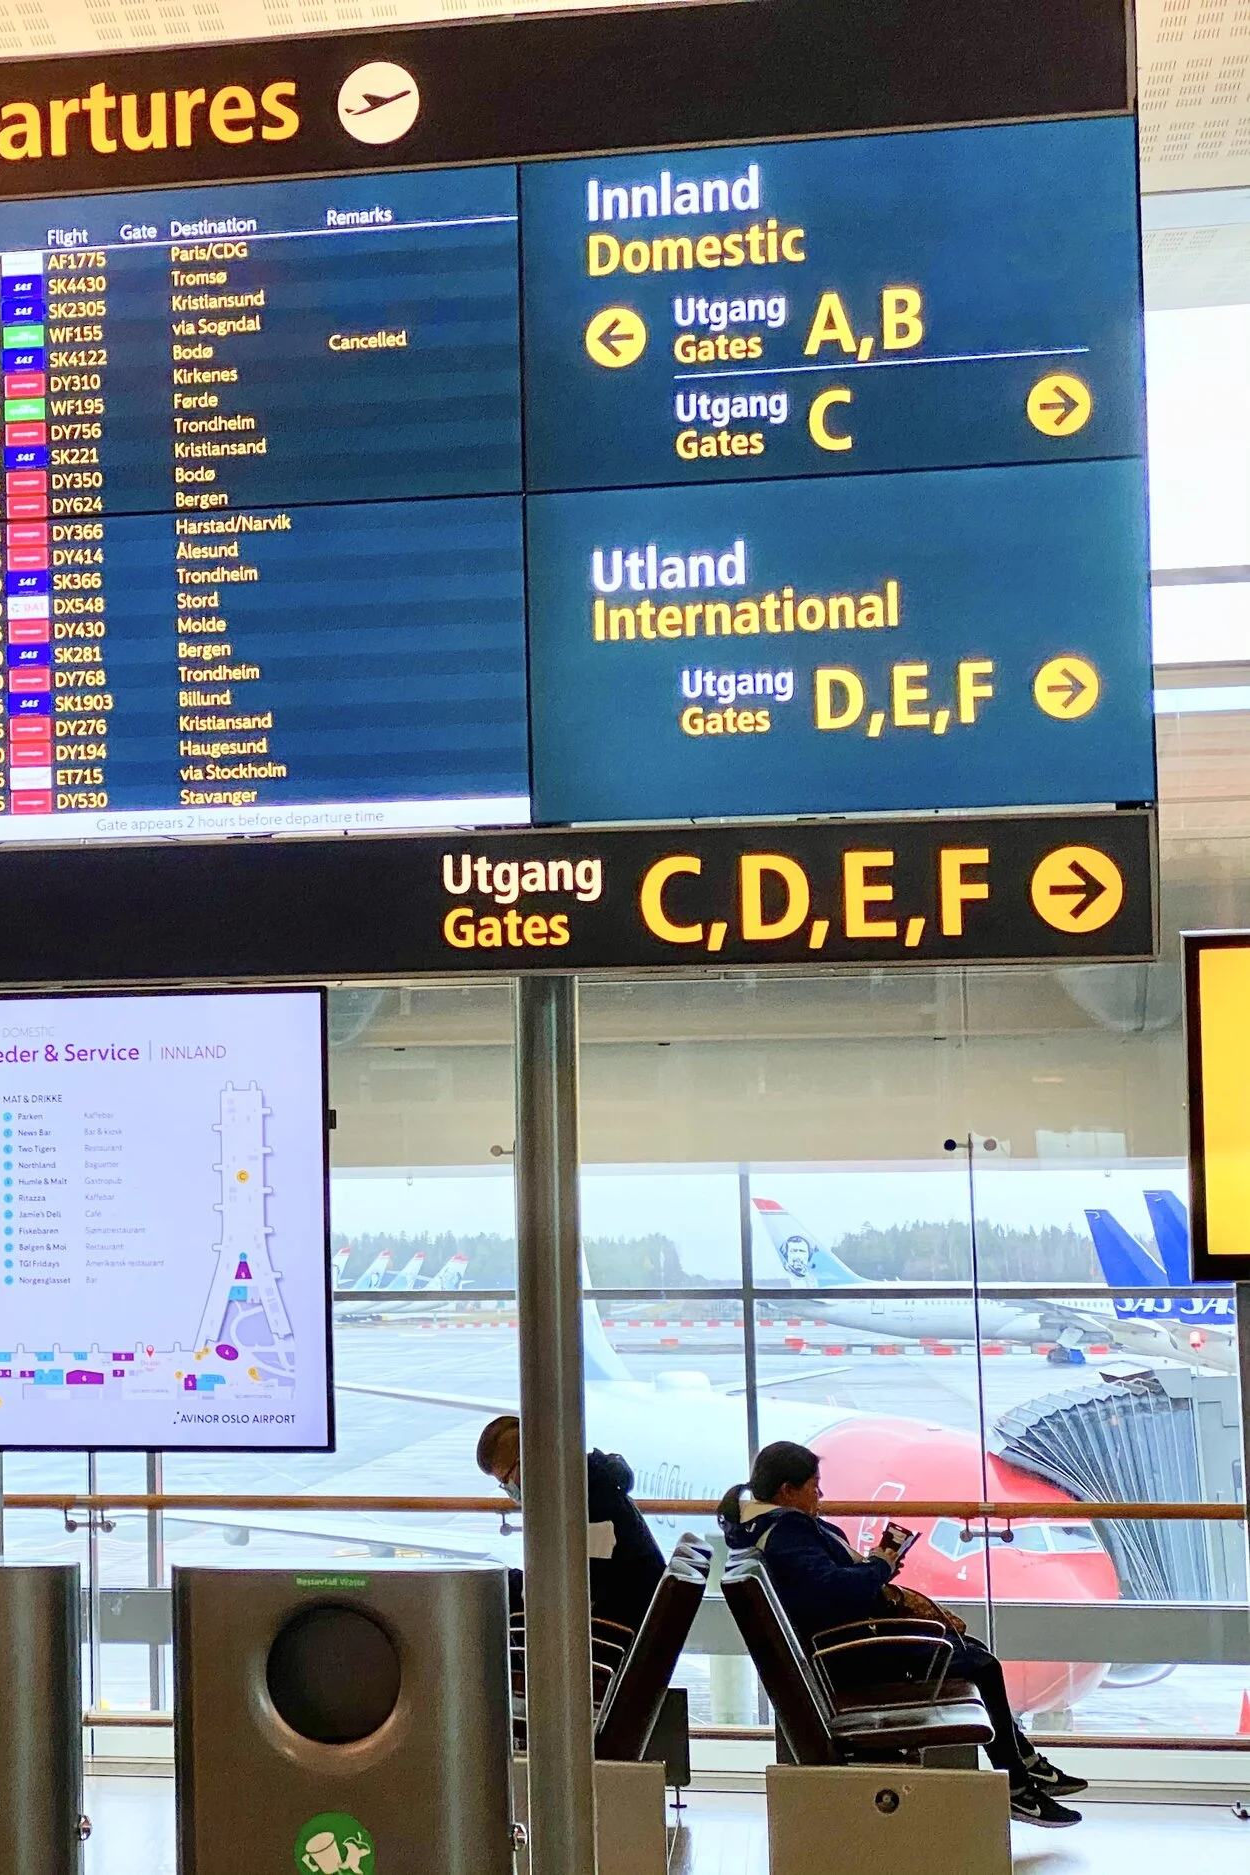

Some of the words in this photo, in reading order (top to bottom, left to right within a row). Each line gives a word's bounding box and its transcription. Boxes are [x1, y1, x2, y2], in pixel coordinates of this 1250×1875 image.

[588, 165, 759, 221] Innland
[48, 252, 106, 270] AF1775
[171, 242, 247, 262] Paris/CDG
[589, 218, 805, 276] Domestic
[49, 325, 103, 343] WF155
[172, 320, 195, 335] via
[198, 315, 261, 336] Sogndal
[675, 296, 785, 331] Utgang
[804, 286, 923, 361] A,B
[50, 349, 107, 368] SK4122
[173, 344, 213, 360] Bodø
[329, 330, 407, 350] Cancelled
[674, 335, 762, 363] Gates
[676, 394, 787, 427] Utgang
[809, 389, 852, 450] C
[676, 430, 764, 459] Gates
[592, 541, 745, 592] Utland
[54, 597, 104, 614] DX548
[177, 591, 218, 609] Stord
[593, 582, 898, 641] International
[682, 670, 793, 704] Utgang
[816, 661, 993, 737] D,E,F
[682, 707, 770, 735] Gates
[57, 768, 103, 785] ET715
[180, 765, 203, 780] via
[206, 762, 286, 780] Stockholm
[444, 855, 601, 904] Utgang
[641, 849, 989, 951] C,D,E,F
[444, 908, 569, 947] Gates
[65, 1044, 139, 1061] Service
[161, 1045, 226, 1060] INNLAND
[3, 1095, 21, 1103] MAT
[32, 1095, 62, 1103] DRIKKE
[181, 1415, 219, 1423] AVINOR
[222, 1415, 249, 1423] OSLO
[253, 1415, 295, 1423] AIRPORT
